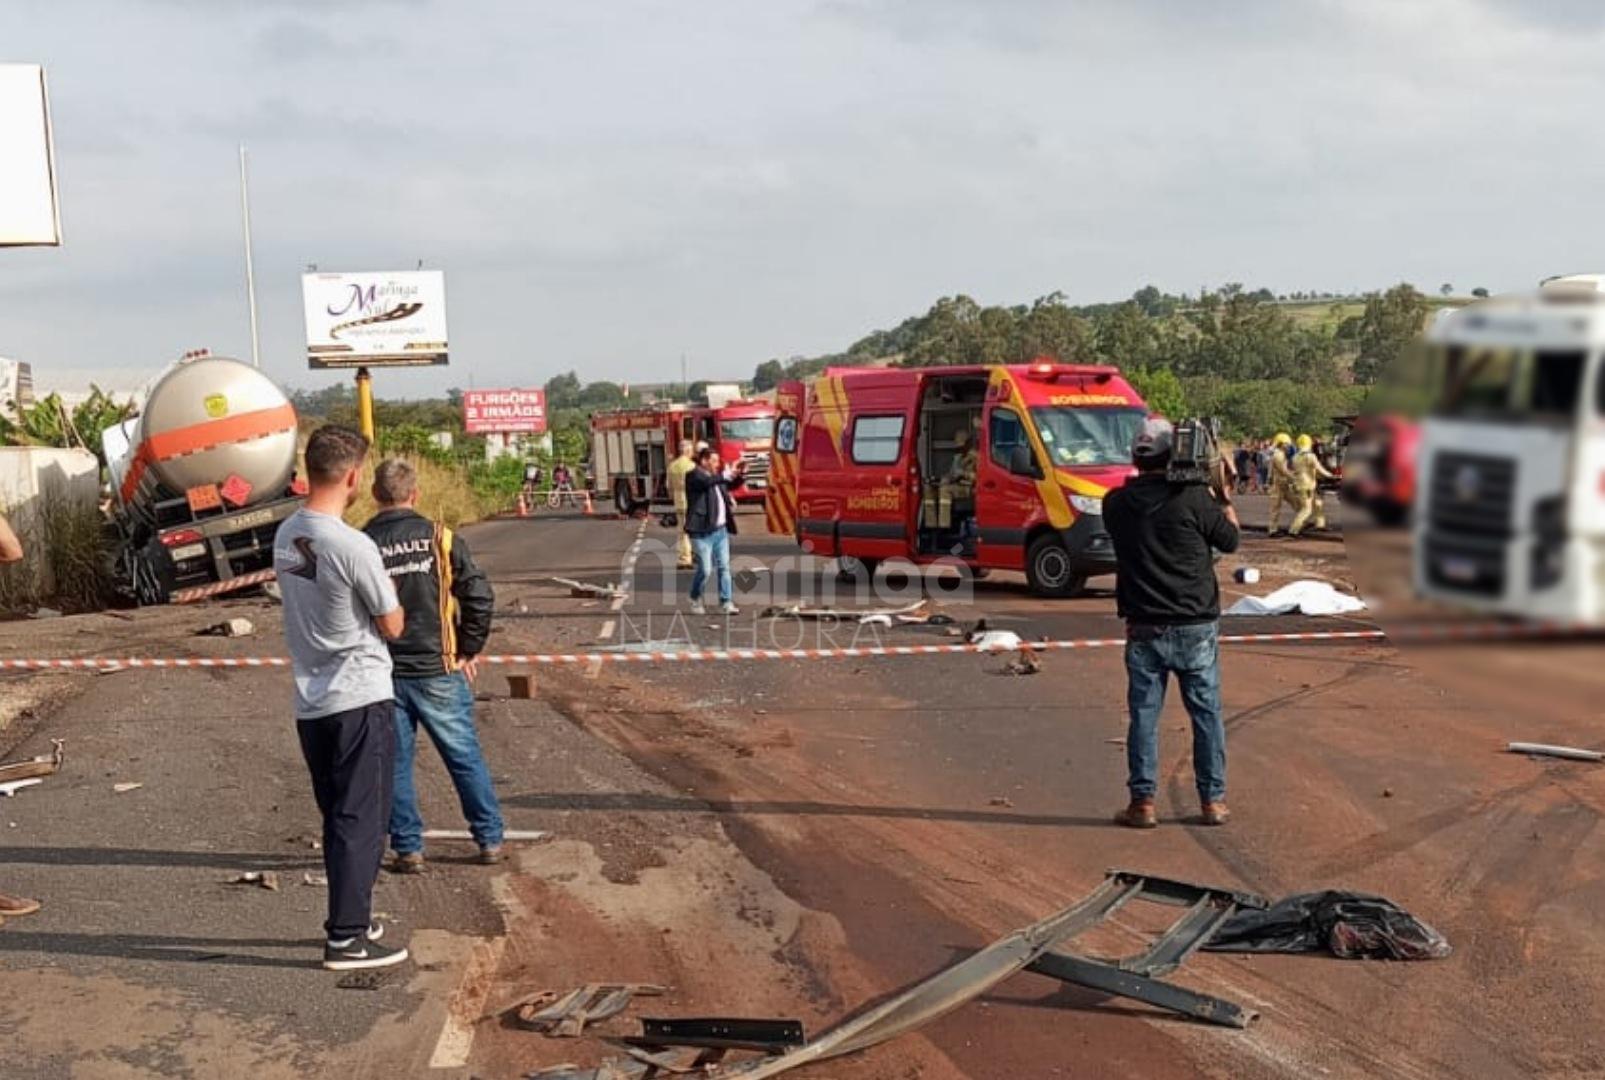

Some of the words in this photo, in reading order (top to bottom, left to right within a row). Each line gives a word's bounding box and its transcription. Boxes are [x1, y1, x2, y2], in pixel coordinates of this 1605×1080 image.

[470, 391, 538, 405] FURGÕES
[1049, 395, 1128, 405] BOMBEIROS
[466, 407, 478, 419] 2
[482, 404, 543, 418] IRMÃOS
[846, 496, 900, 510] BOMBEIROS
[381, 538, 432, 558] NAULT
